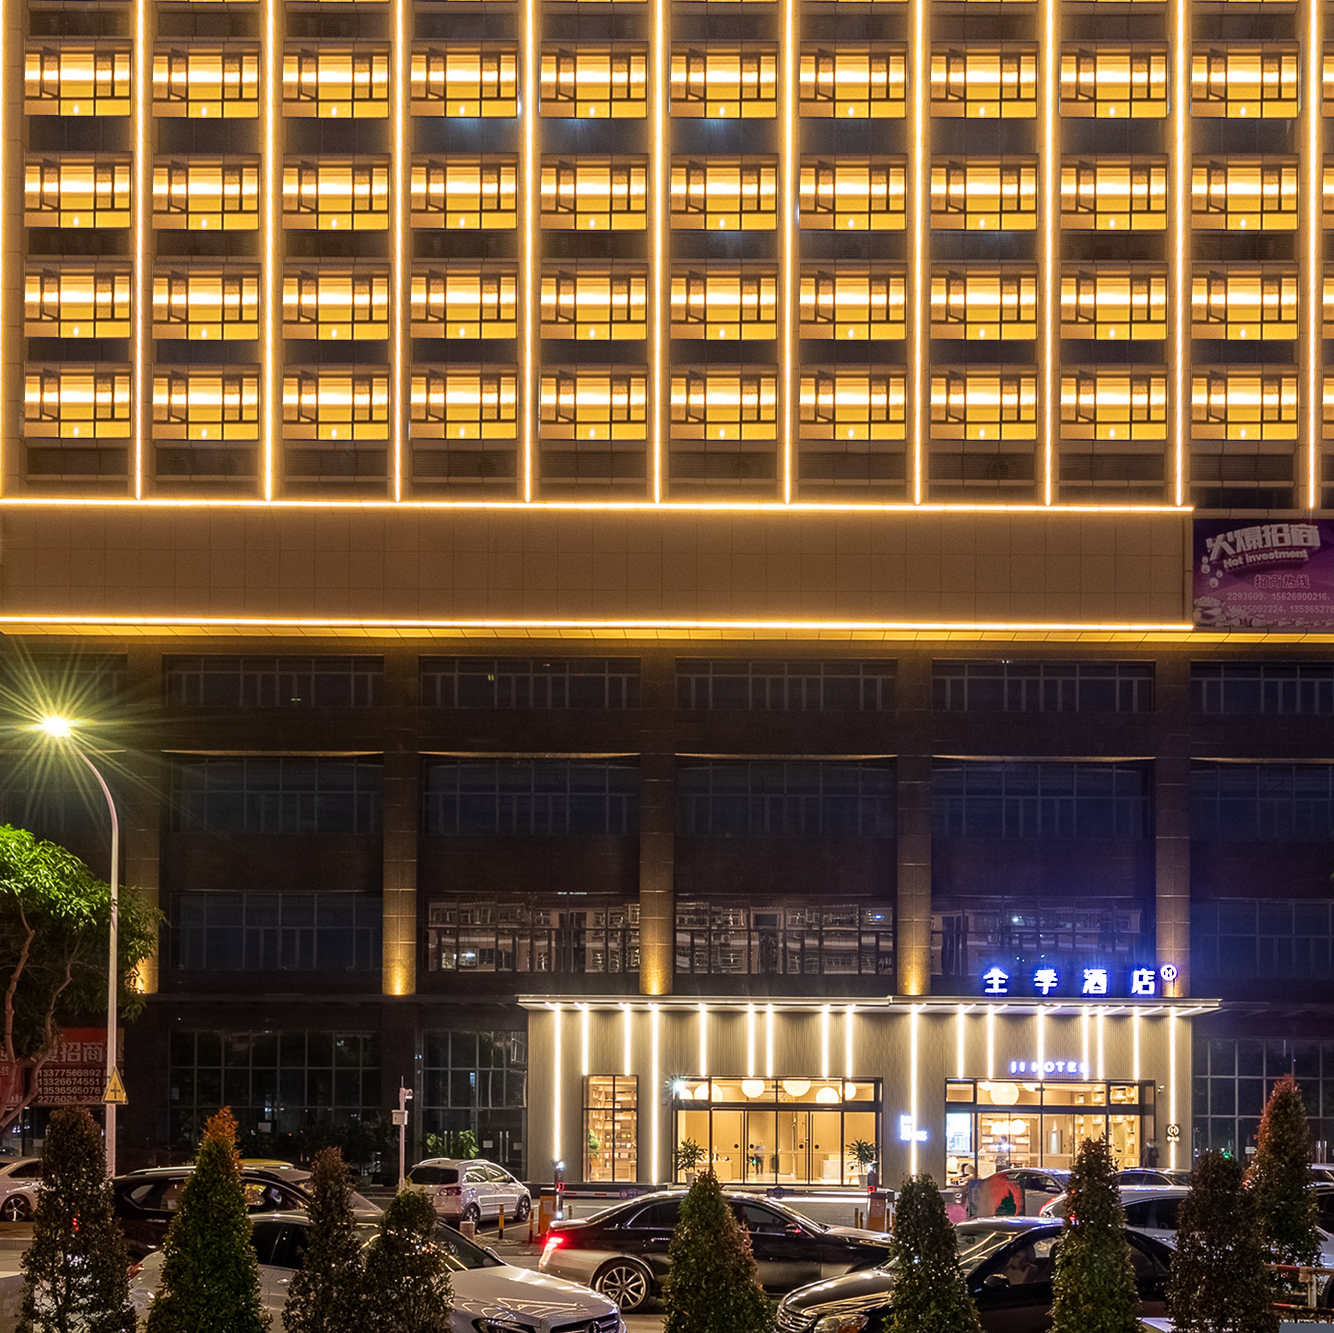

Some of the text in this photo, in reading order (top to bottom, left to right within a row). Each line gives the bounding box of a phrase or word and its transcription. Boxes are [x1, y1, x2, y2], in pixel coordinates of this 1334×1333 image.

[1205, 523, 1321, 562] 火爆招商
[1223, 549, 1308, 569] Hot investment
[1253, 573, 1311, 589] 招商热线
[982, 967, 1157, 995] 全季酒店
